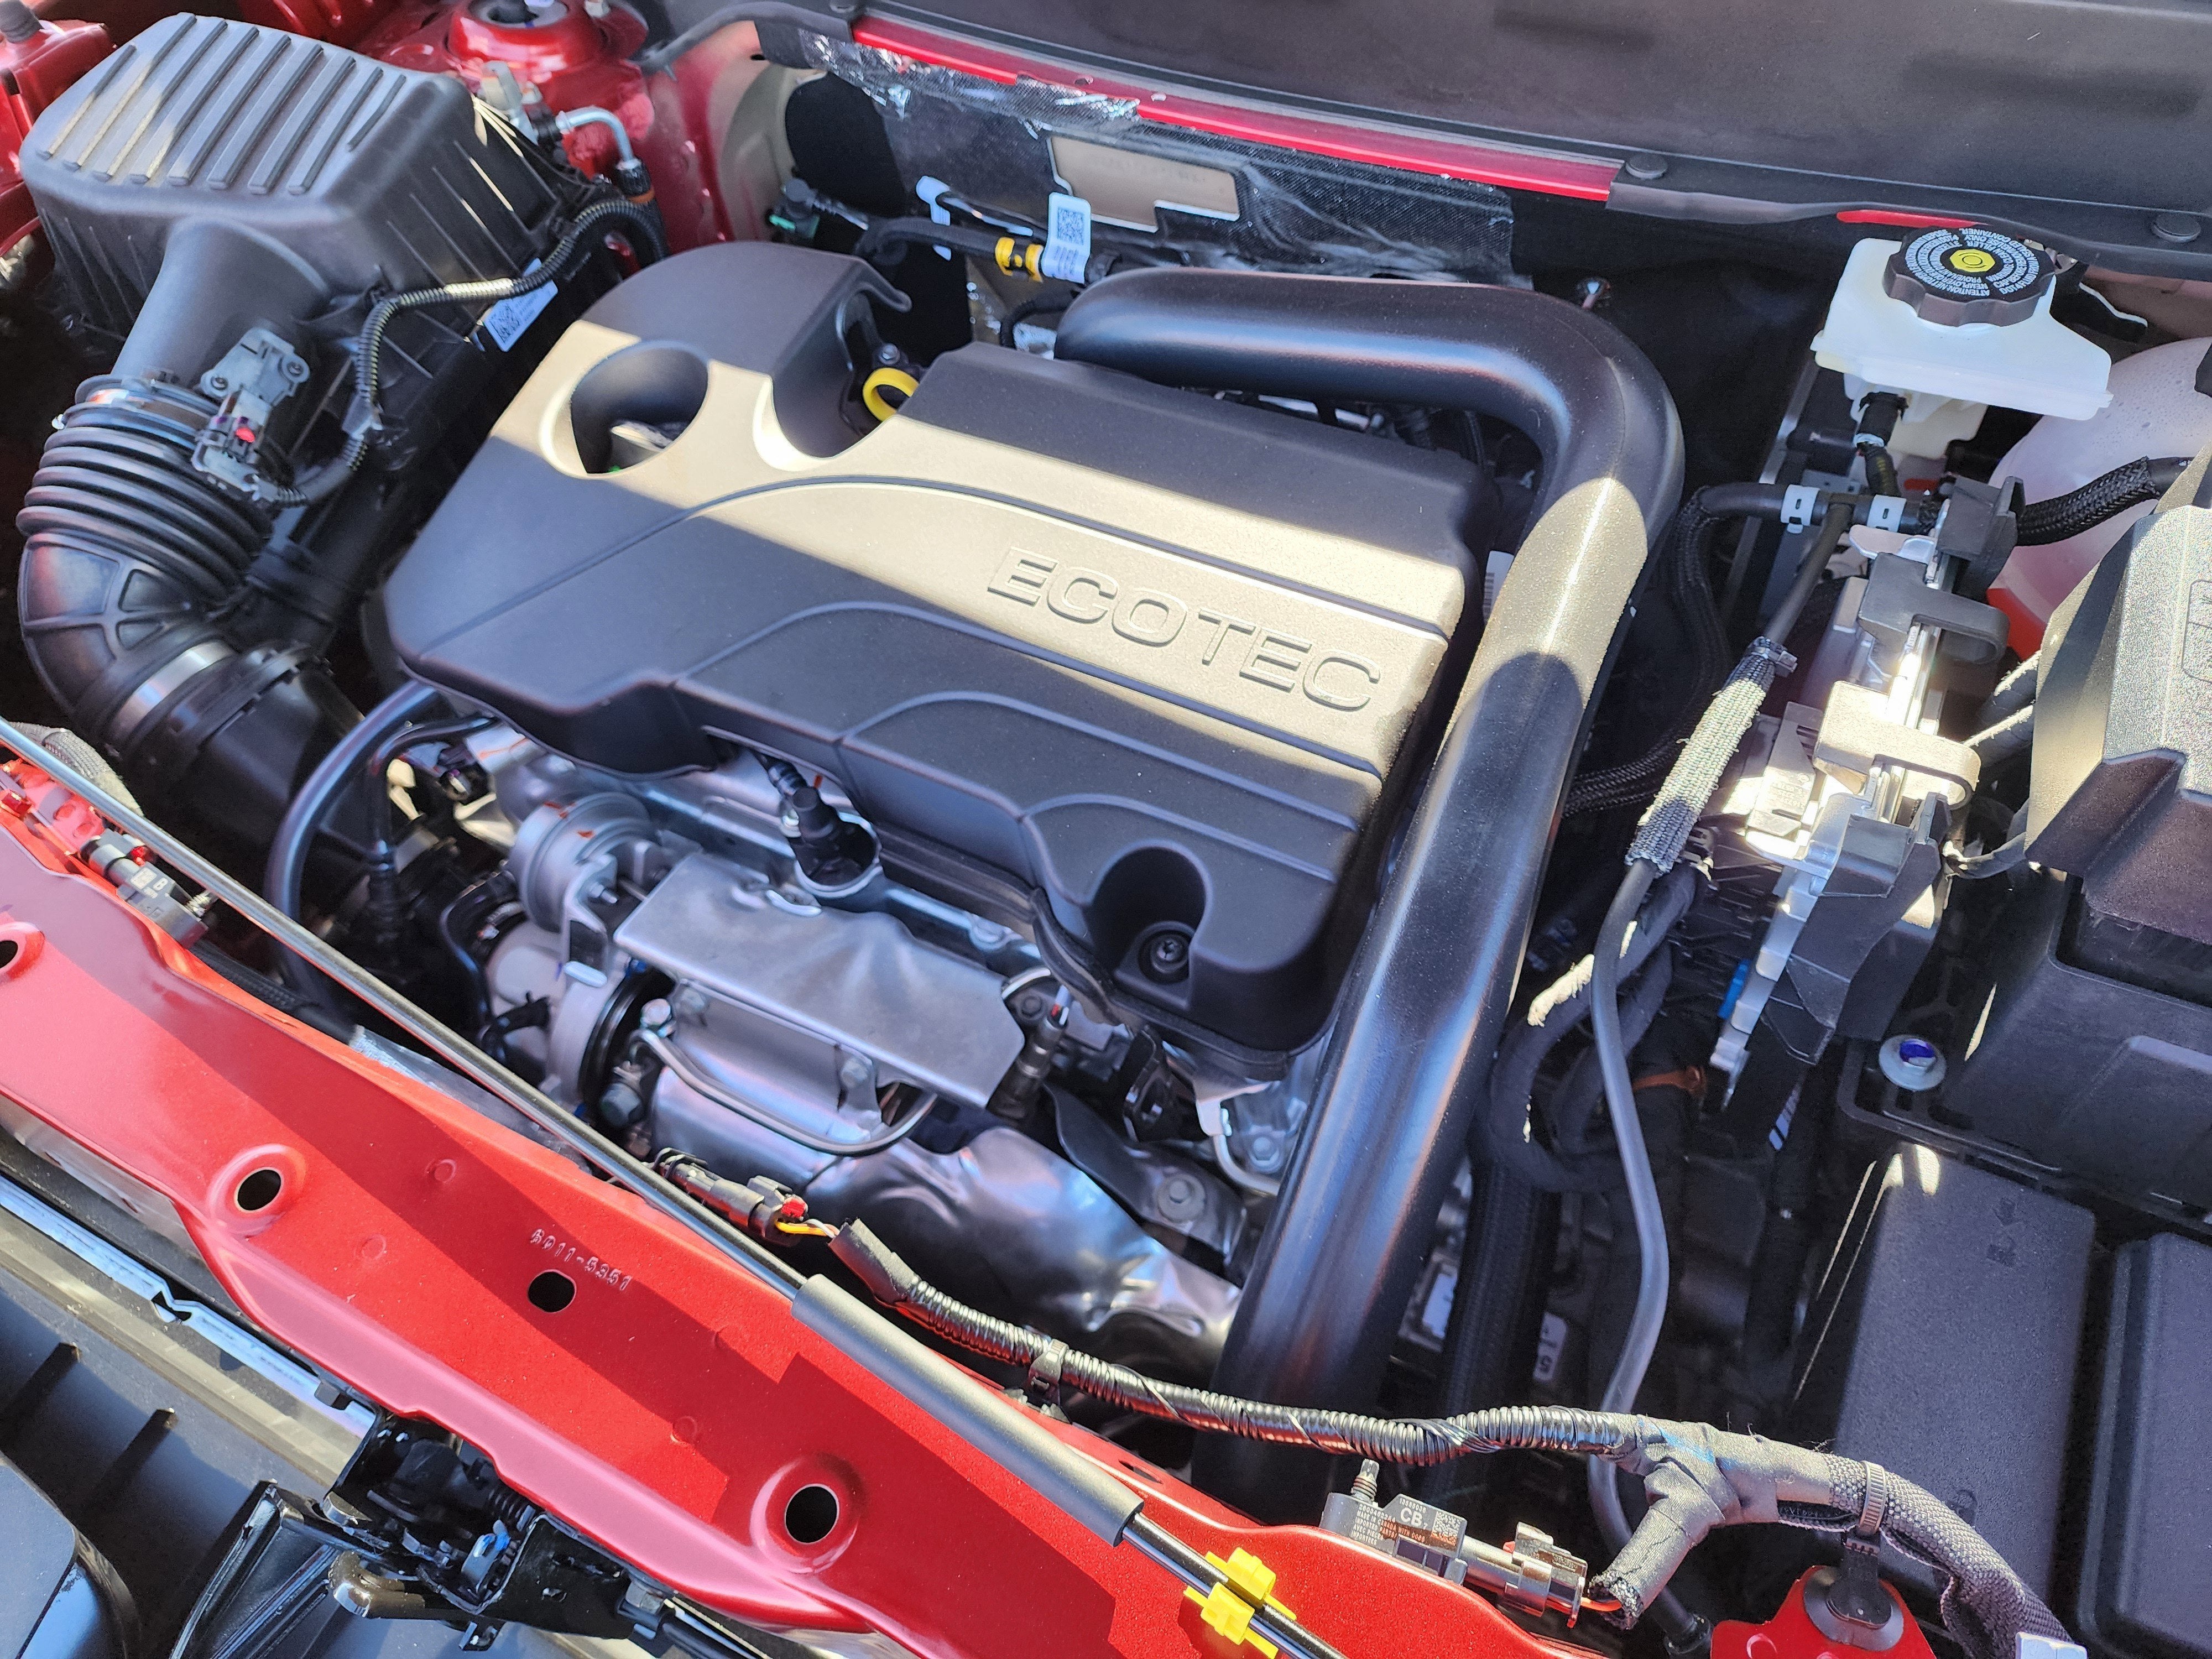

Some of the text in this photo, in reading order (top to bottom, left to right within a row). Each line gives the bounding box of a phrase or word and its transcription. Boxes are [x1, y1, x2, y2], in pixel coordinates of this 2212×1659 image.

[1966, 241, 1996, 251] FILLER
[1985, 238, 2005, 247] USE
[2006, 240, 2034, 257] SEALED
[2026, 260, 2039, 274] FROM
[1913, 270, 1948, 290] NETTOYER
[1992, 279, 2015, 289] CAP
[986, 546, 1381, 712] ECOTEC
[1400, 1507, 1422, 1527] CB
[1378, 1518, 1396, 1532] CANADA
[1398, 1526, 1410, 1537] WITH
